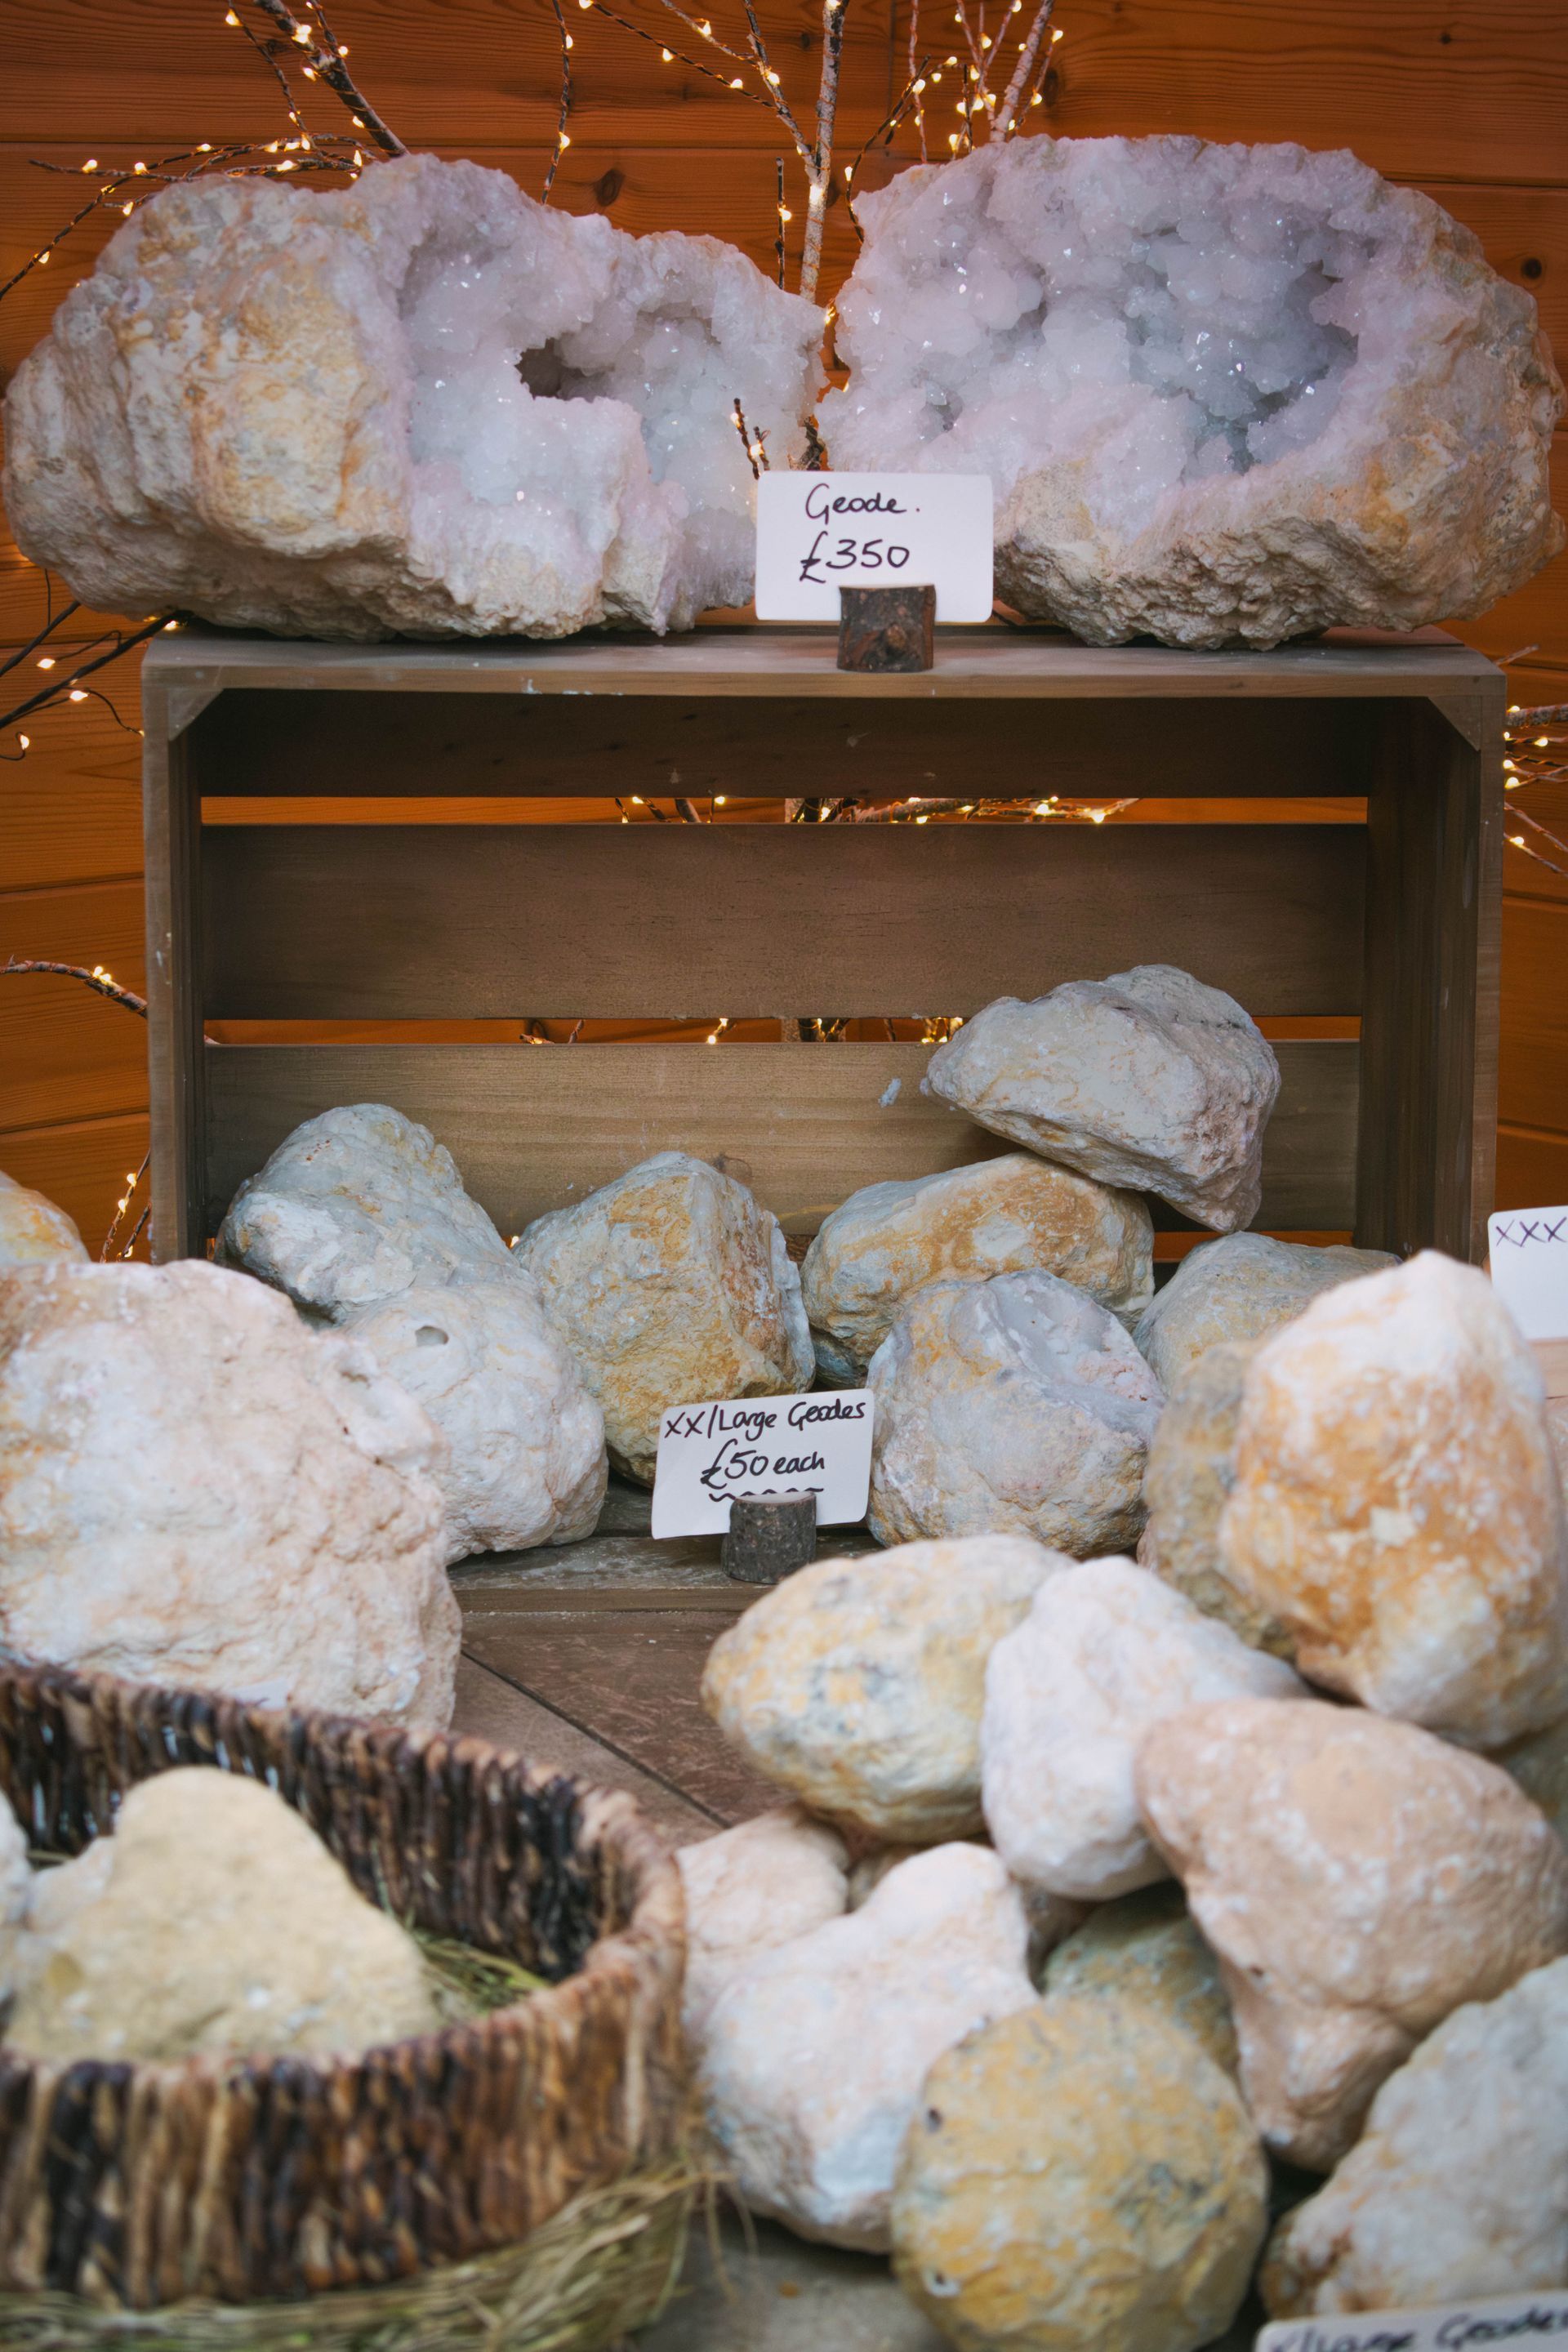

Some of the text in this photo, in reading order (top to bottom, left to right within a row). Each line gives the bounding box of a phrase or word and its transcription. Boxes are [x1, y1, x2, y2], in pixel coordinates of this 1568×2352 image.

[799, 530, 910, 584] £350
[664, 1398, 866, 1441] XX/Large Geodes
[700, 1438, 825, 1490] £50 each
